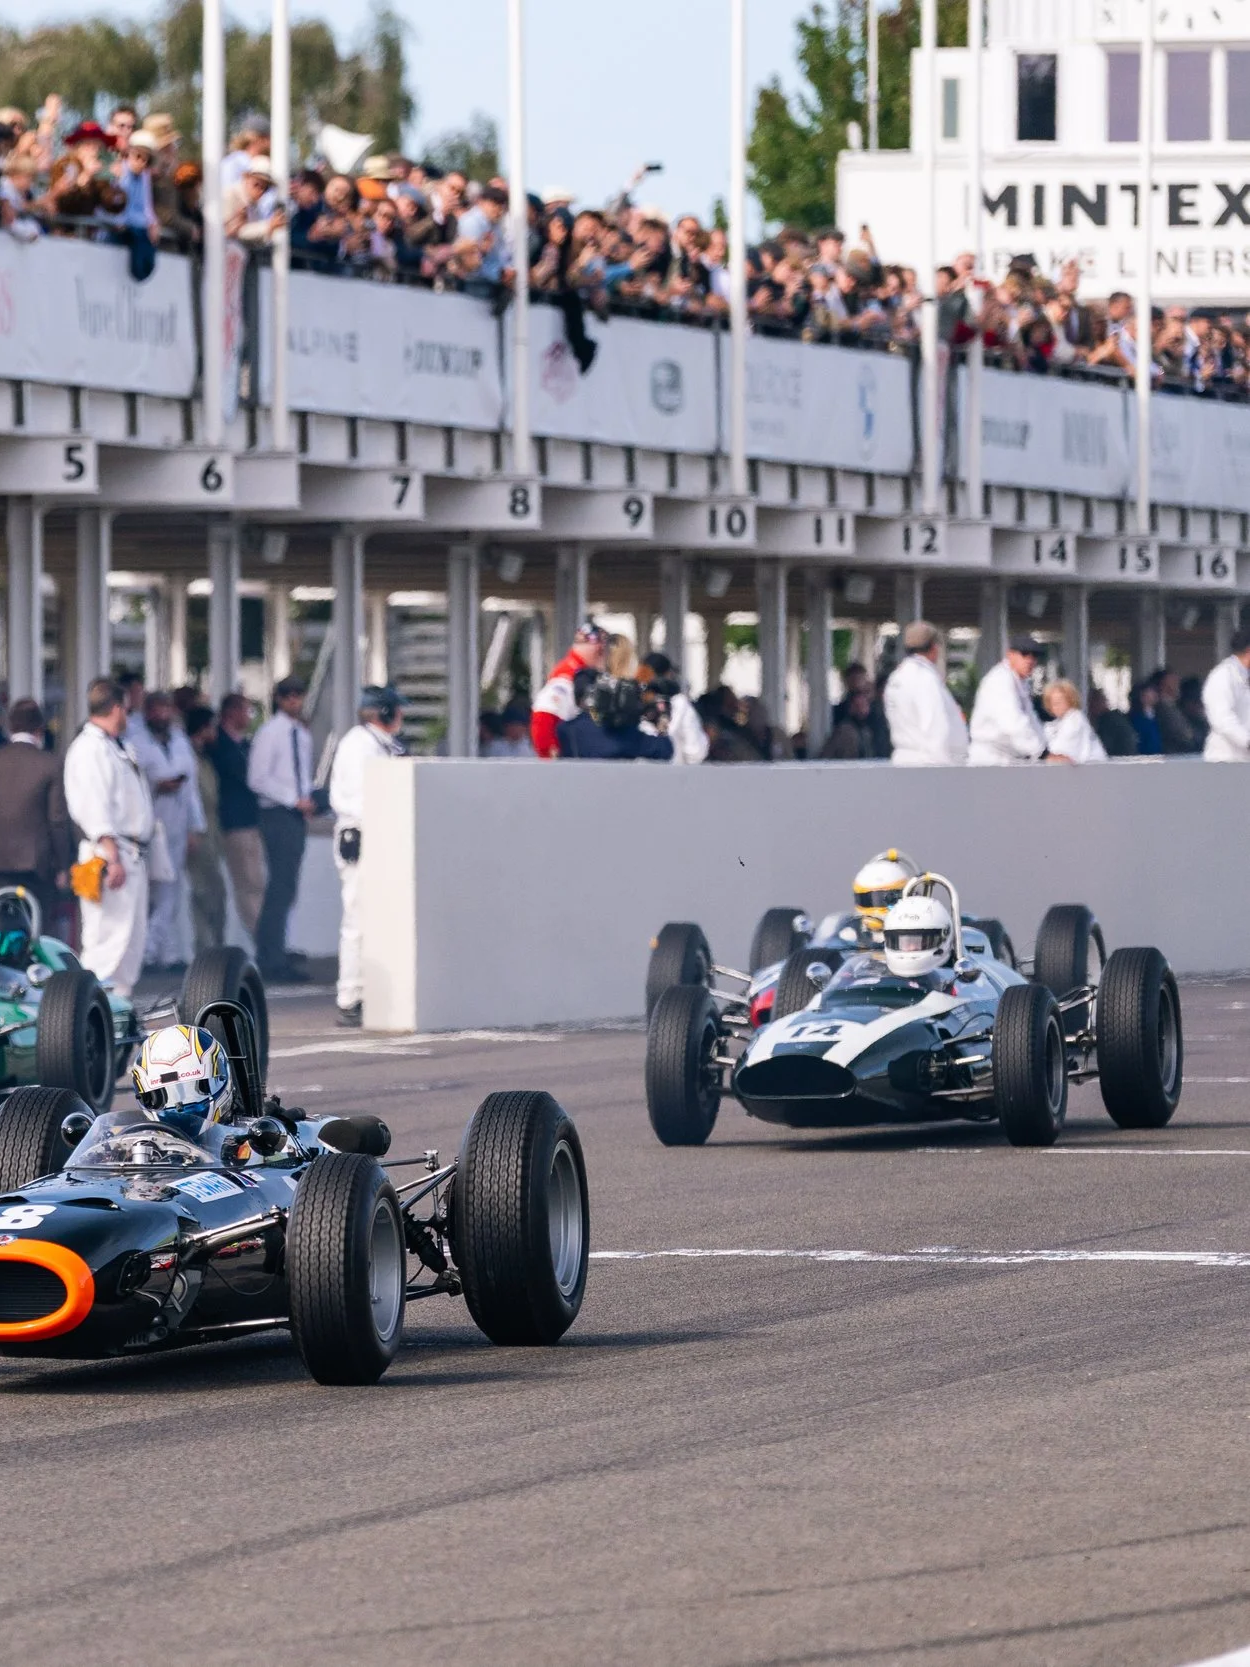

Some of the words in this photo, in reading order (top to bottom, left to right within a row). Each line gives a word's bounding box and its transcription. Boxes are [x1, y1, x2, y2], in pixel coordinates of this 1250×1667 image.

[63, 443, 86, 482] 5
[200, 458, 224, 493] 6
[391, 474, 413, 507] 7
[508, 484, 531, 518] 8
[622, 496, 645, 528] 9
[708, 505, 748, 538] 10
[812, 514, 846, 546] 11
[902, 522, 938, 554] 12
[1033, 535, 1068, 565] 14
[1118, 543, 1152, 572] 15
[1194, 550, 1229, 580] 16
[789, 1024, 845, 1040] 14
[175, 1173, 237, 1200] STEWART
